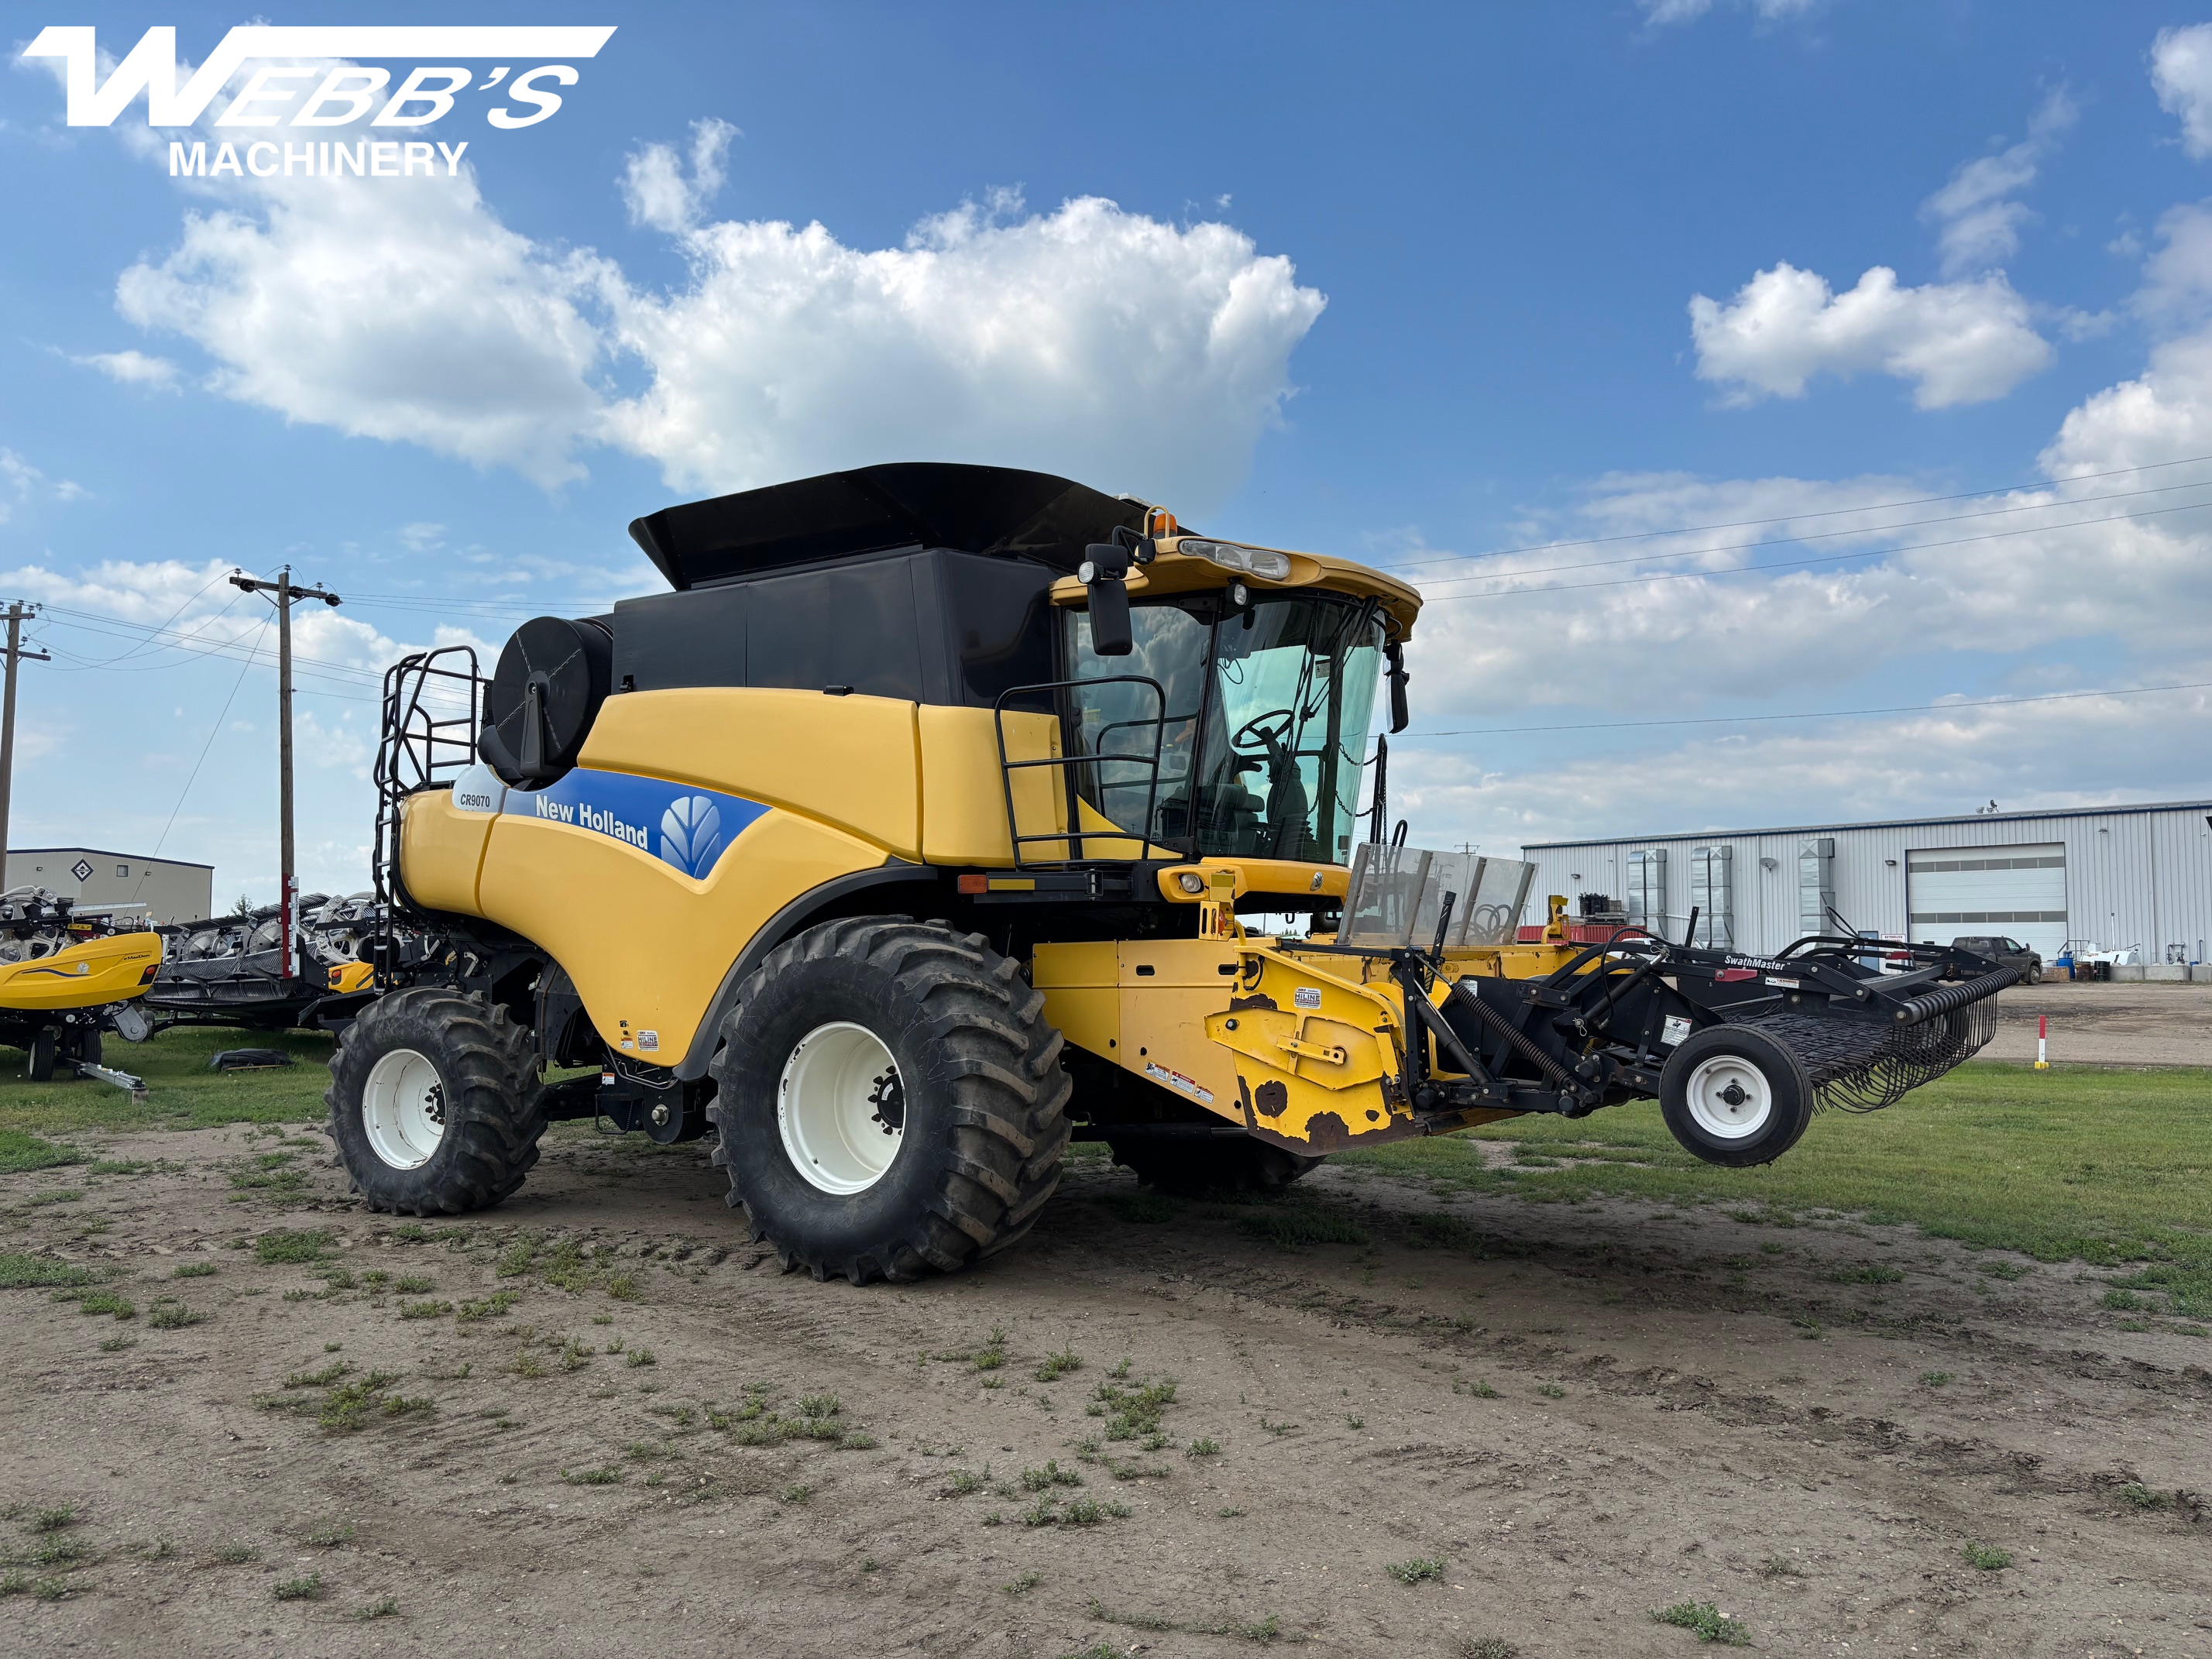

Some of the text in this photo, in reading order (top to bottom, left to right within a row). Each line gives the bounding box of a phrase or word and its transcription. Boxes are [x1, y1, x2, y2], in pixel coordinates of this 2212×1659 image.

[460, 793, 490, 808] CR9070
[536, 794, 648, 850] New Holland
[1724, 955, 1785, 970] SwathMaster
